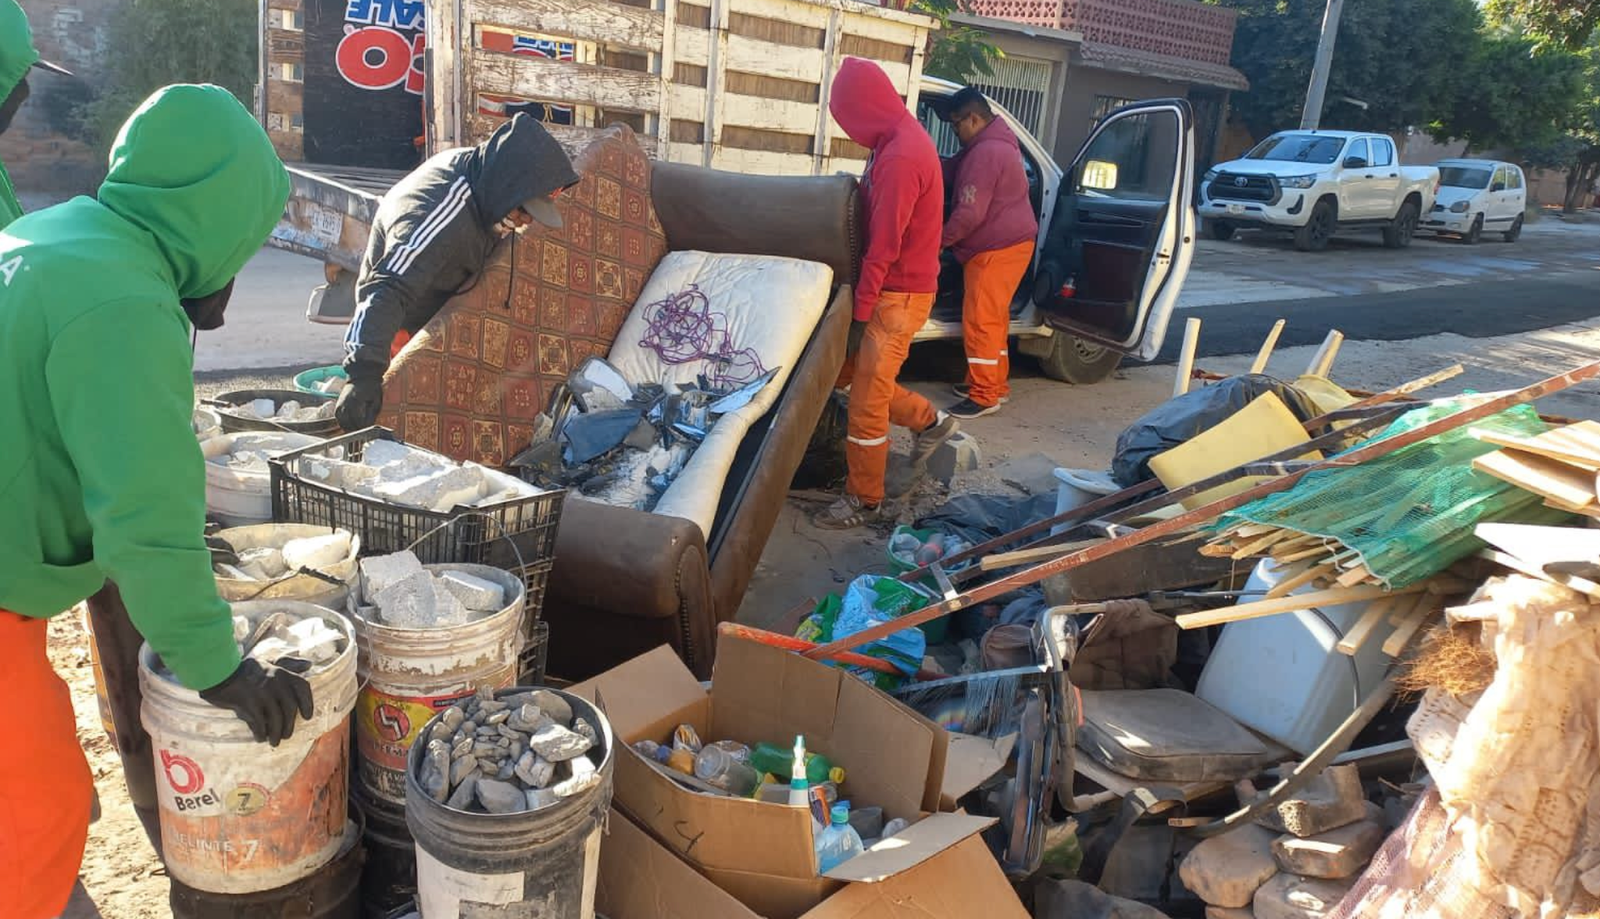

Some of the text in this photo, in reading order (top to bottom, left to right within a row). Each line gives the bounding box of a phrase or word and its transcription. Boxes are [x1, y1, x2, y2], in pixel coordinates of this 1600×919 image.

[174, 788, 221, 812] Berel
[237, 792, 252, 808] 7
[239, 838, 260, 862] 7
